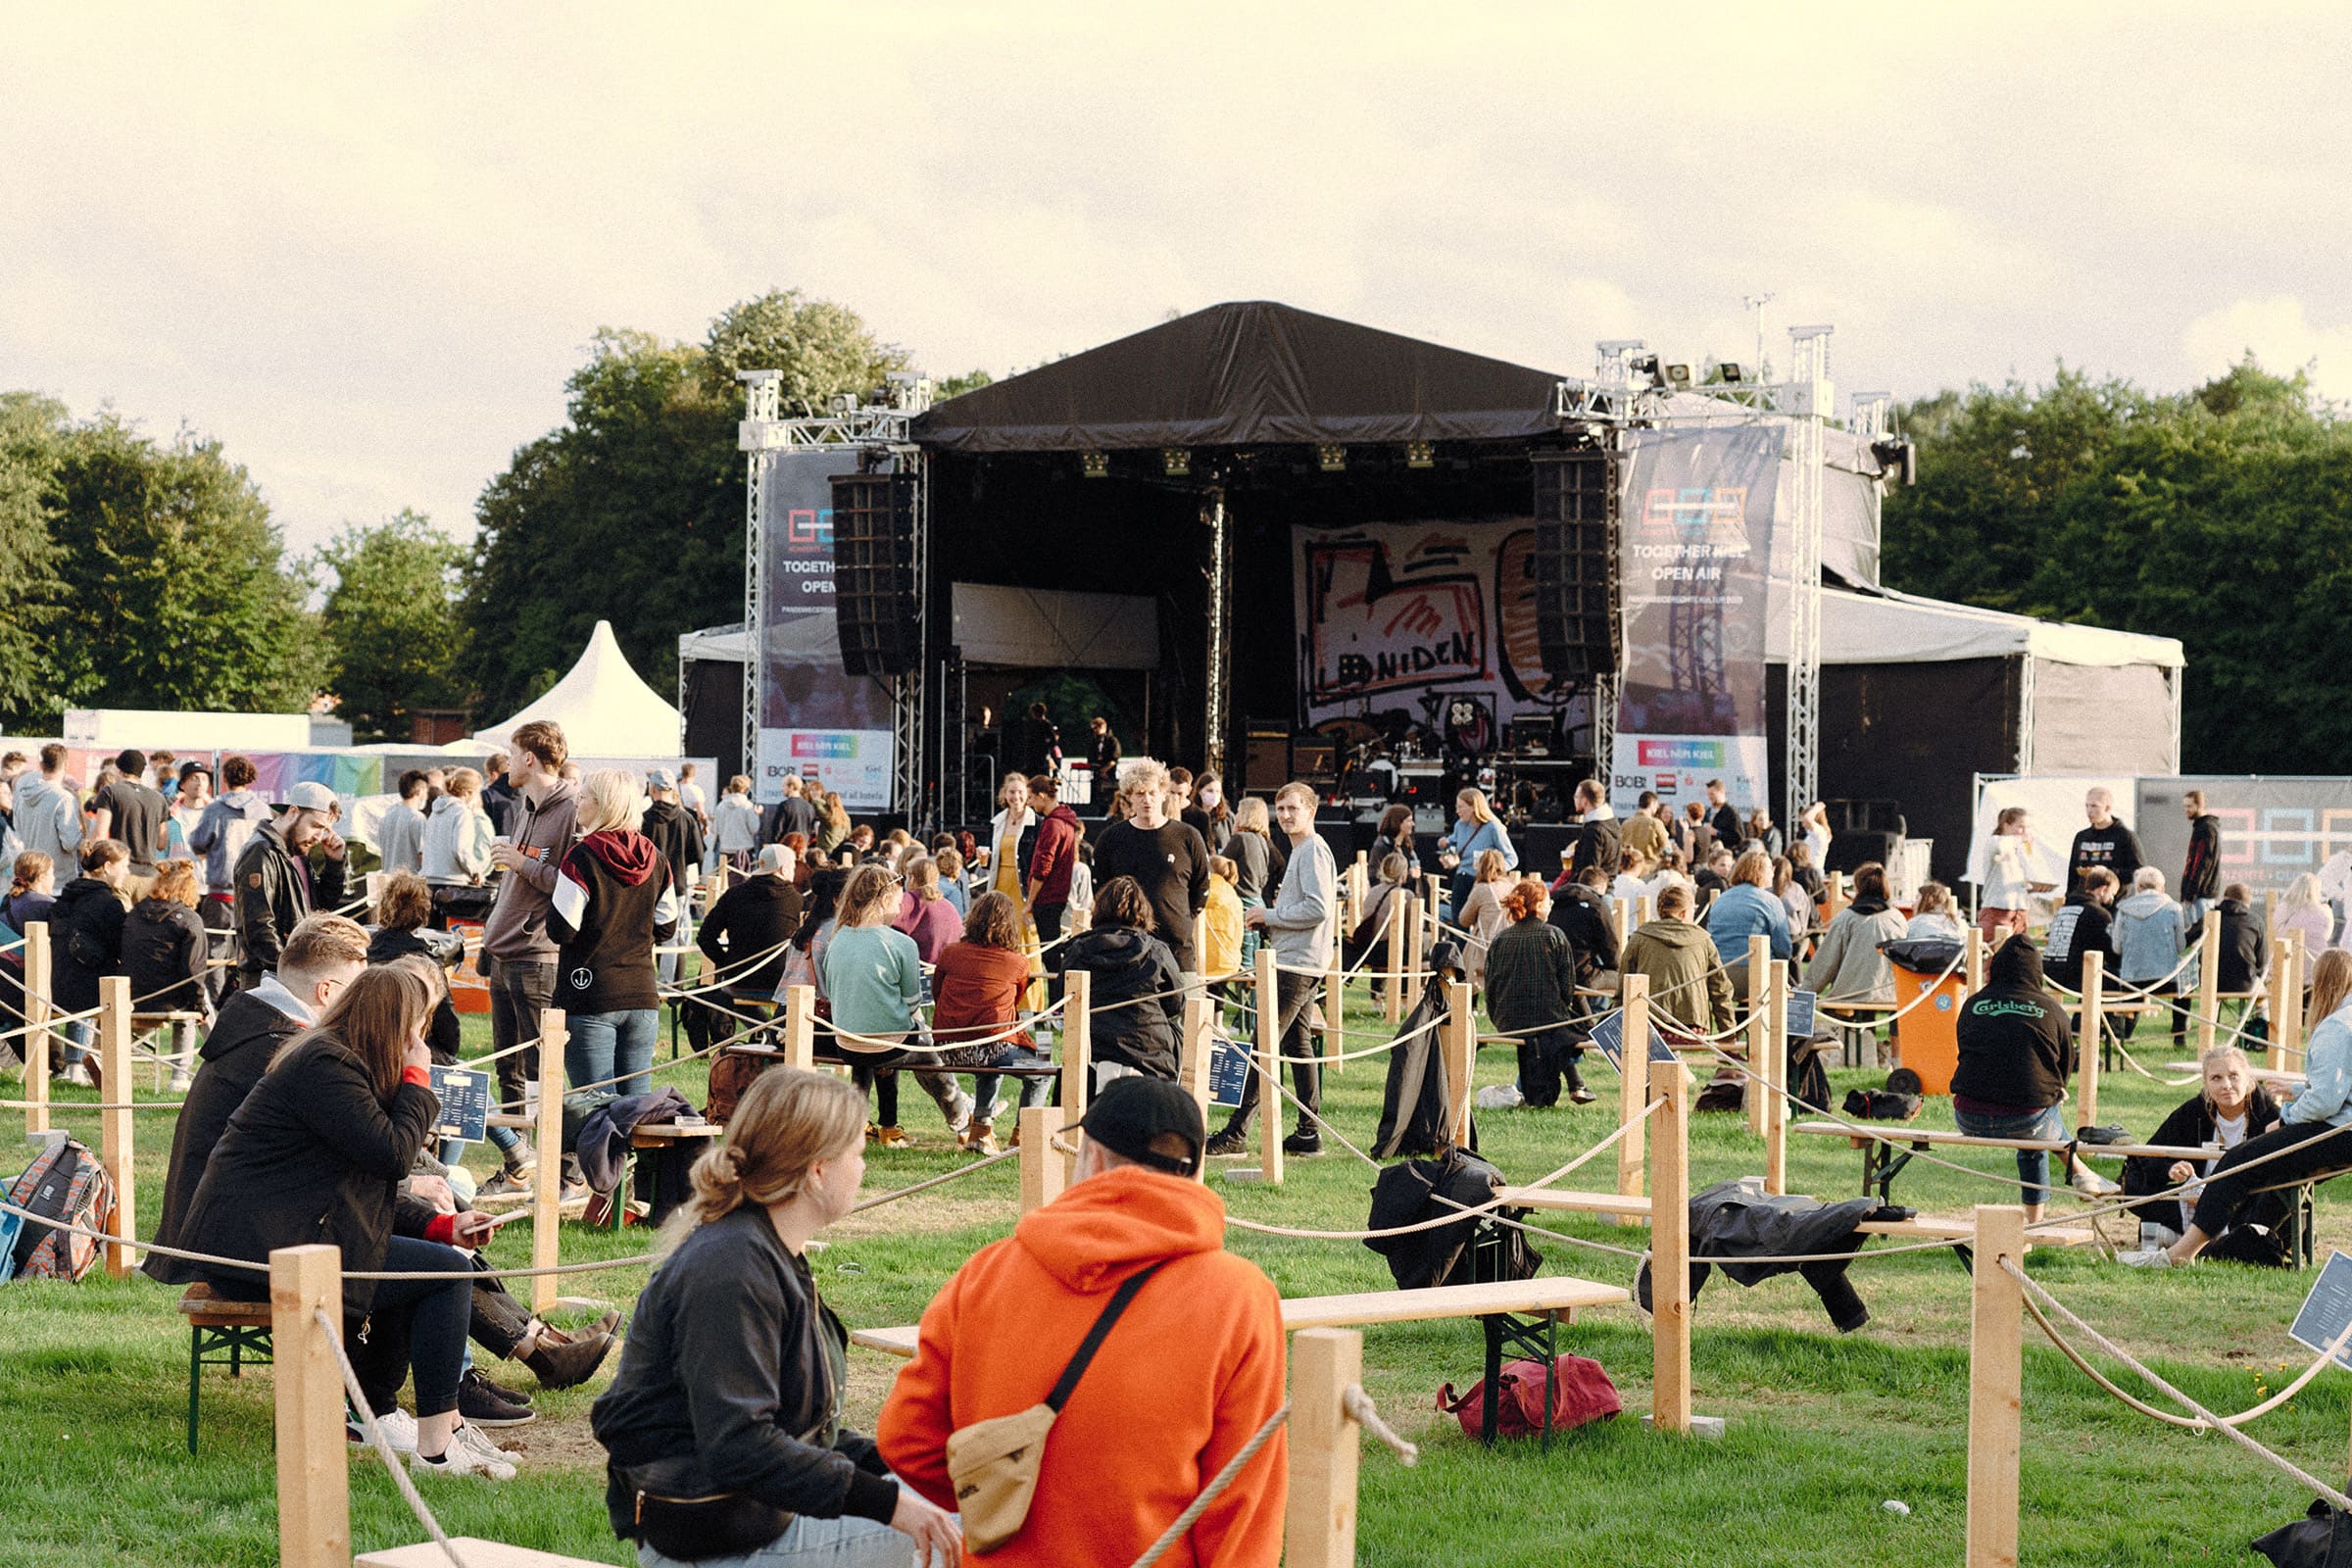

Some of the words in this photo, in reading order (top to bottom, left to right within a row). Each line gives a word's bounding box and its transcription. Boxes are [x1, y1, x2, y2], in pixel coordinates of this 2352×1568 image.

[1633, 544, 1711, 558] TOGETHER
[783, 561, 835, 573] TOGETH
[1651, 566, 1693, 580] OPEN
[1695, 566, 1722, 580] AIR
[1972, 999, 2047, 1018] Carlsberg
